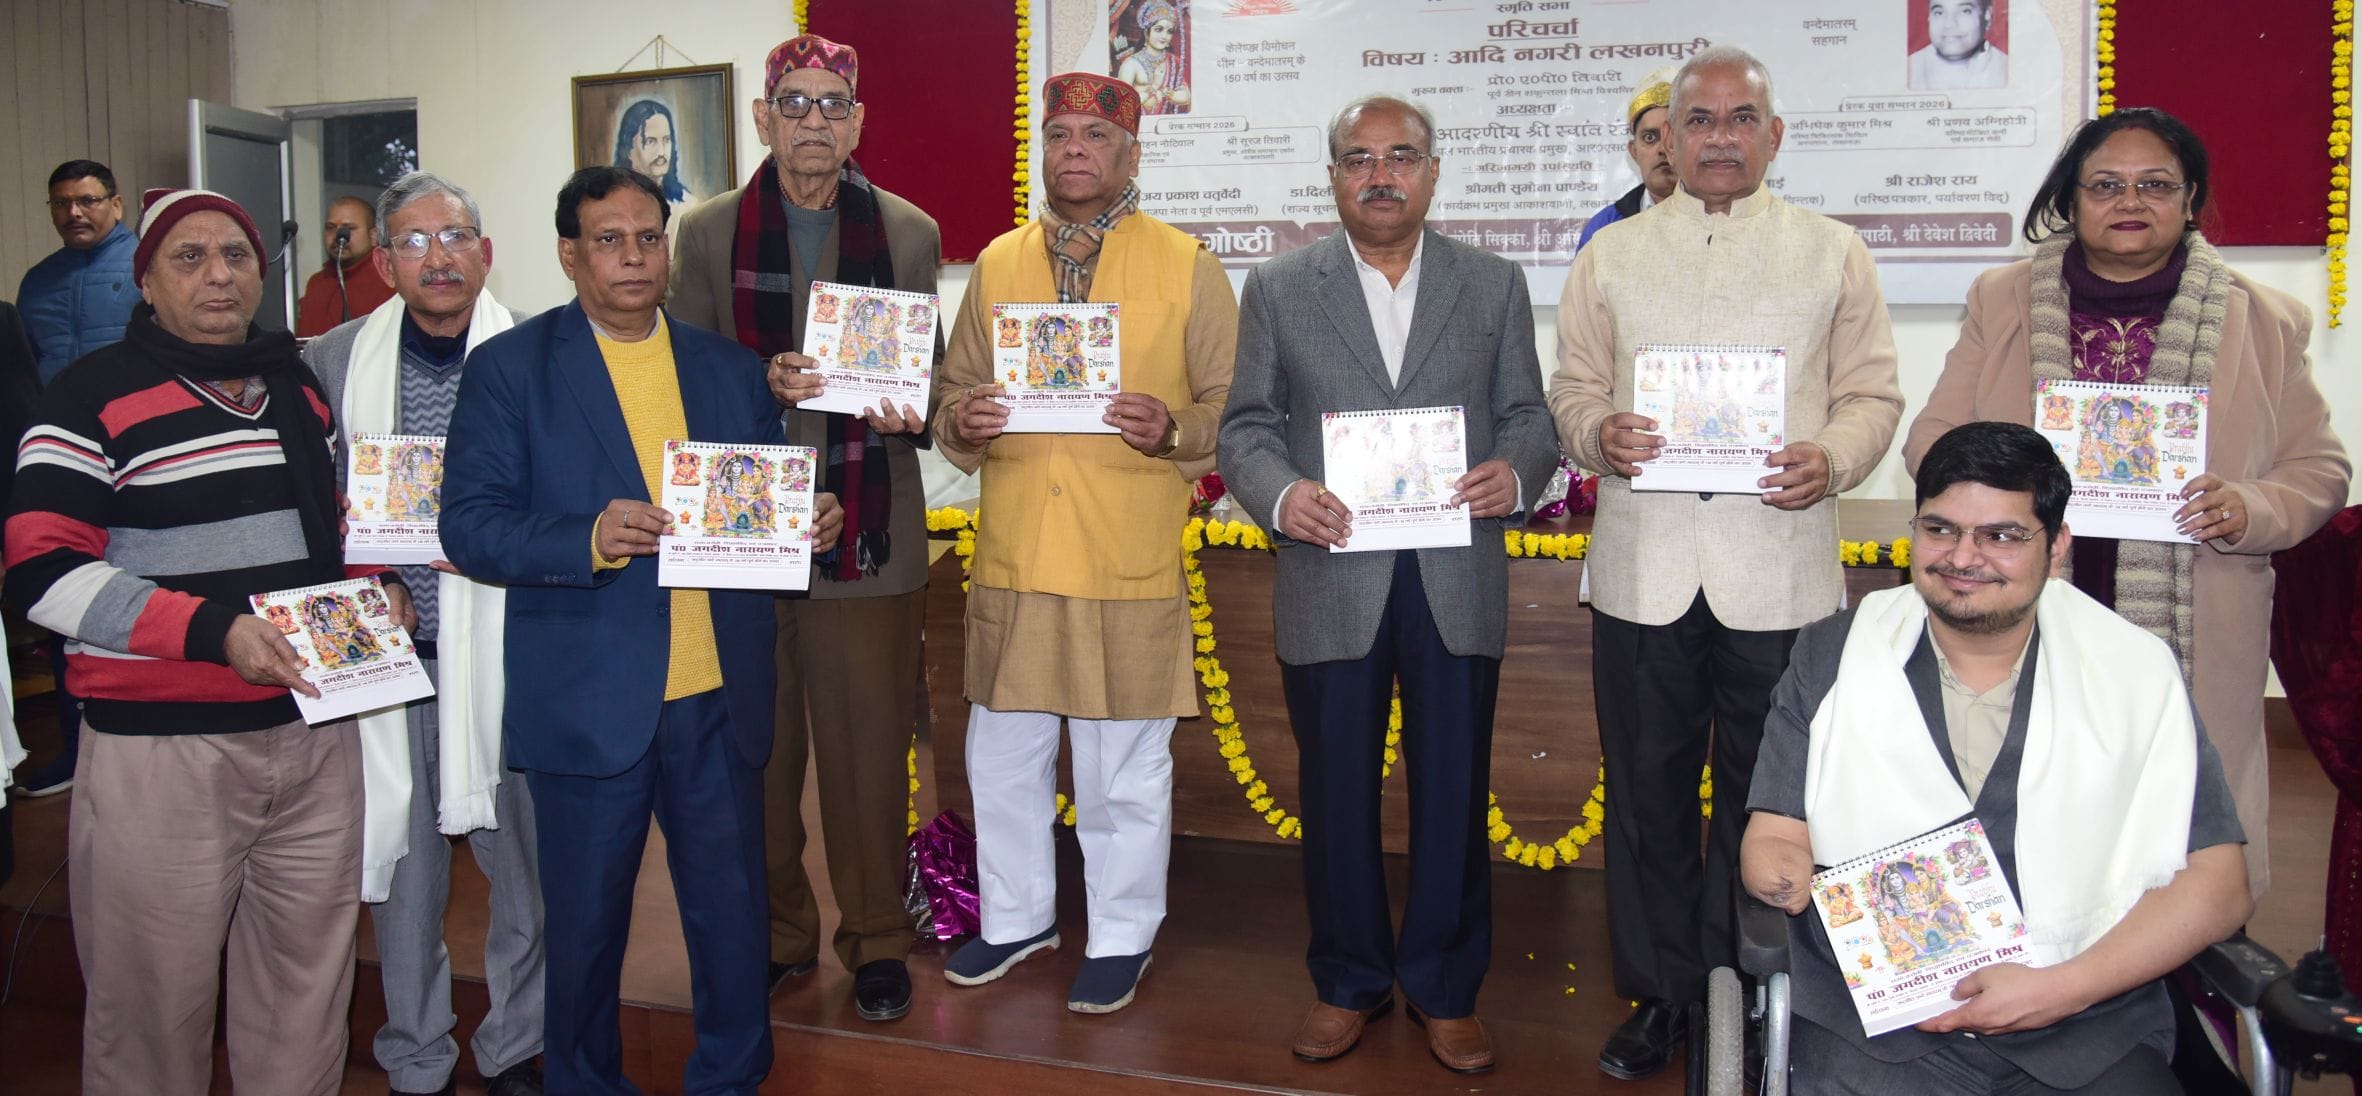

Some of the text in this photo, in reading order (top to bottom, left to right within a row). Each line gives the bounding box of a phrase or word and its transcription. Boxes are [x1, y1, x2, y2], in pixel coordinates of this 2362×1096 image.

[1496, 1, 1533, 14] स्मृति
[1487, 18, 1579, 38] परिचर्चा
[1802, 18, 1858, 31] वन्देमातरम्
[1261, 40, 1296, 52] विमोचन
[1811, 35, 1847, 46] सहगान
[1362, 50, 1426, 67] विषय
[1448, 45, 1506, 64] आदि
[1514, 43, 1583, 61] नगरी
[1247, 56, 1295, 68] वन्देमातरम्
[1224, 74, 1241, 83] 150
[1259, 72, 1272, 82] का
[1273, 71, 1300, 81] उत्सव
[1213, 121, 1235, 129] 2026
[1526, 120, 1550, 139] श्री
[1885, 174, 1977, 188] श्री राजेश राय
[1202, 225, 1276, 254] गोष्ठी
[1903, 225, 1919, 241] श्री
[2161, 450, 2198, 463] Darshan
[1964, 894, 2007, 914] Darshan
